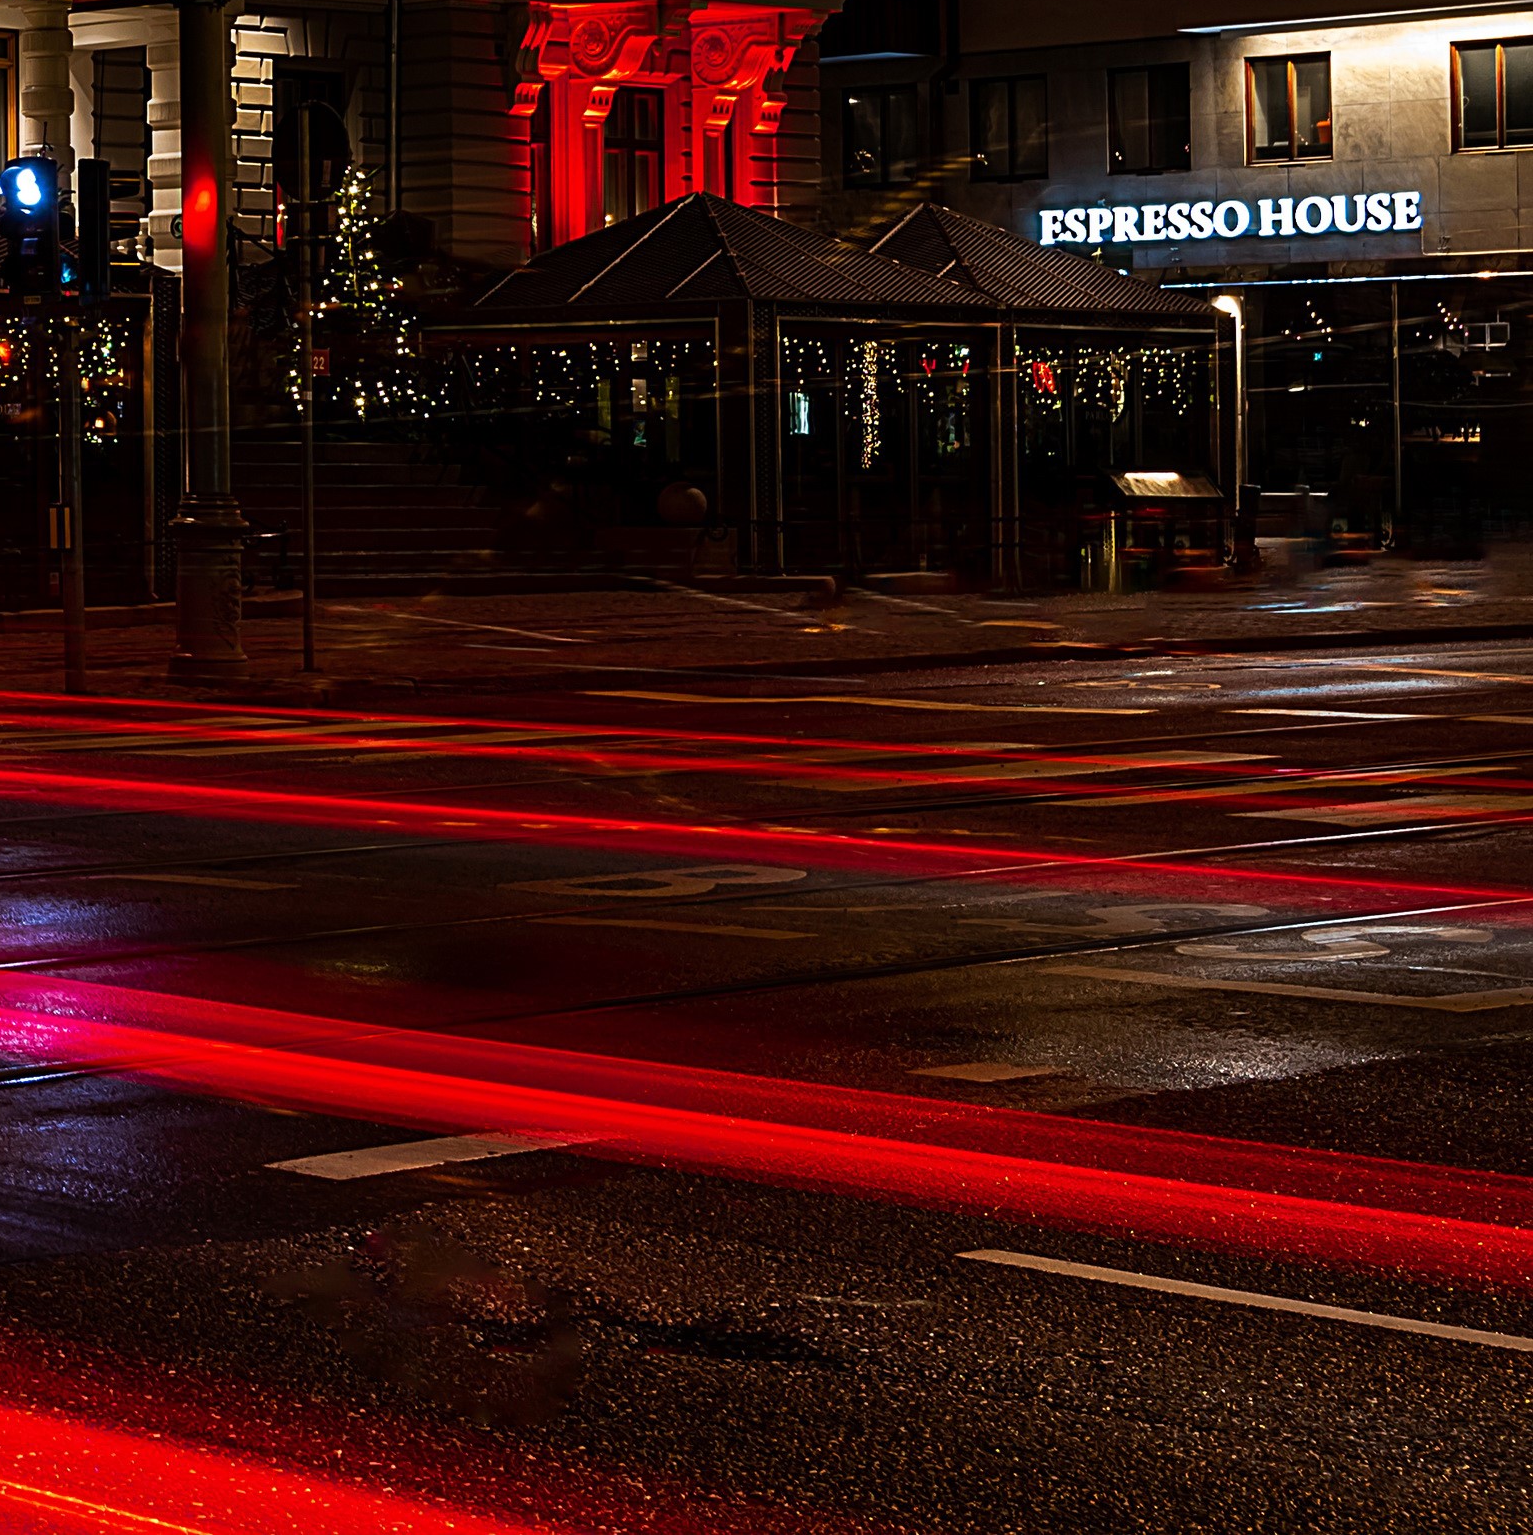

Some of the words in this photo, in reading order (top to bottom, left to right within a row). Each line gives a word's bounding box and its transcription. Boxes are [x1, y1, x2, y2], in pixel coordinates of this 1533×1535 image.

[1038, 200, 1251, 246] ESPRESSO
[1258, 191, 1424, 237] HOUSE
[313, 356, 325, 370] 22
